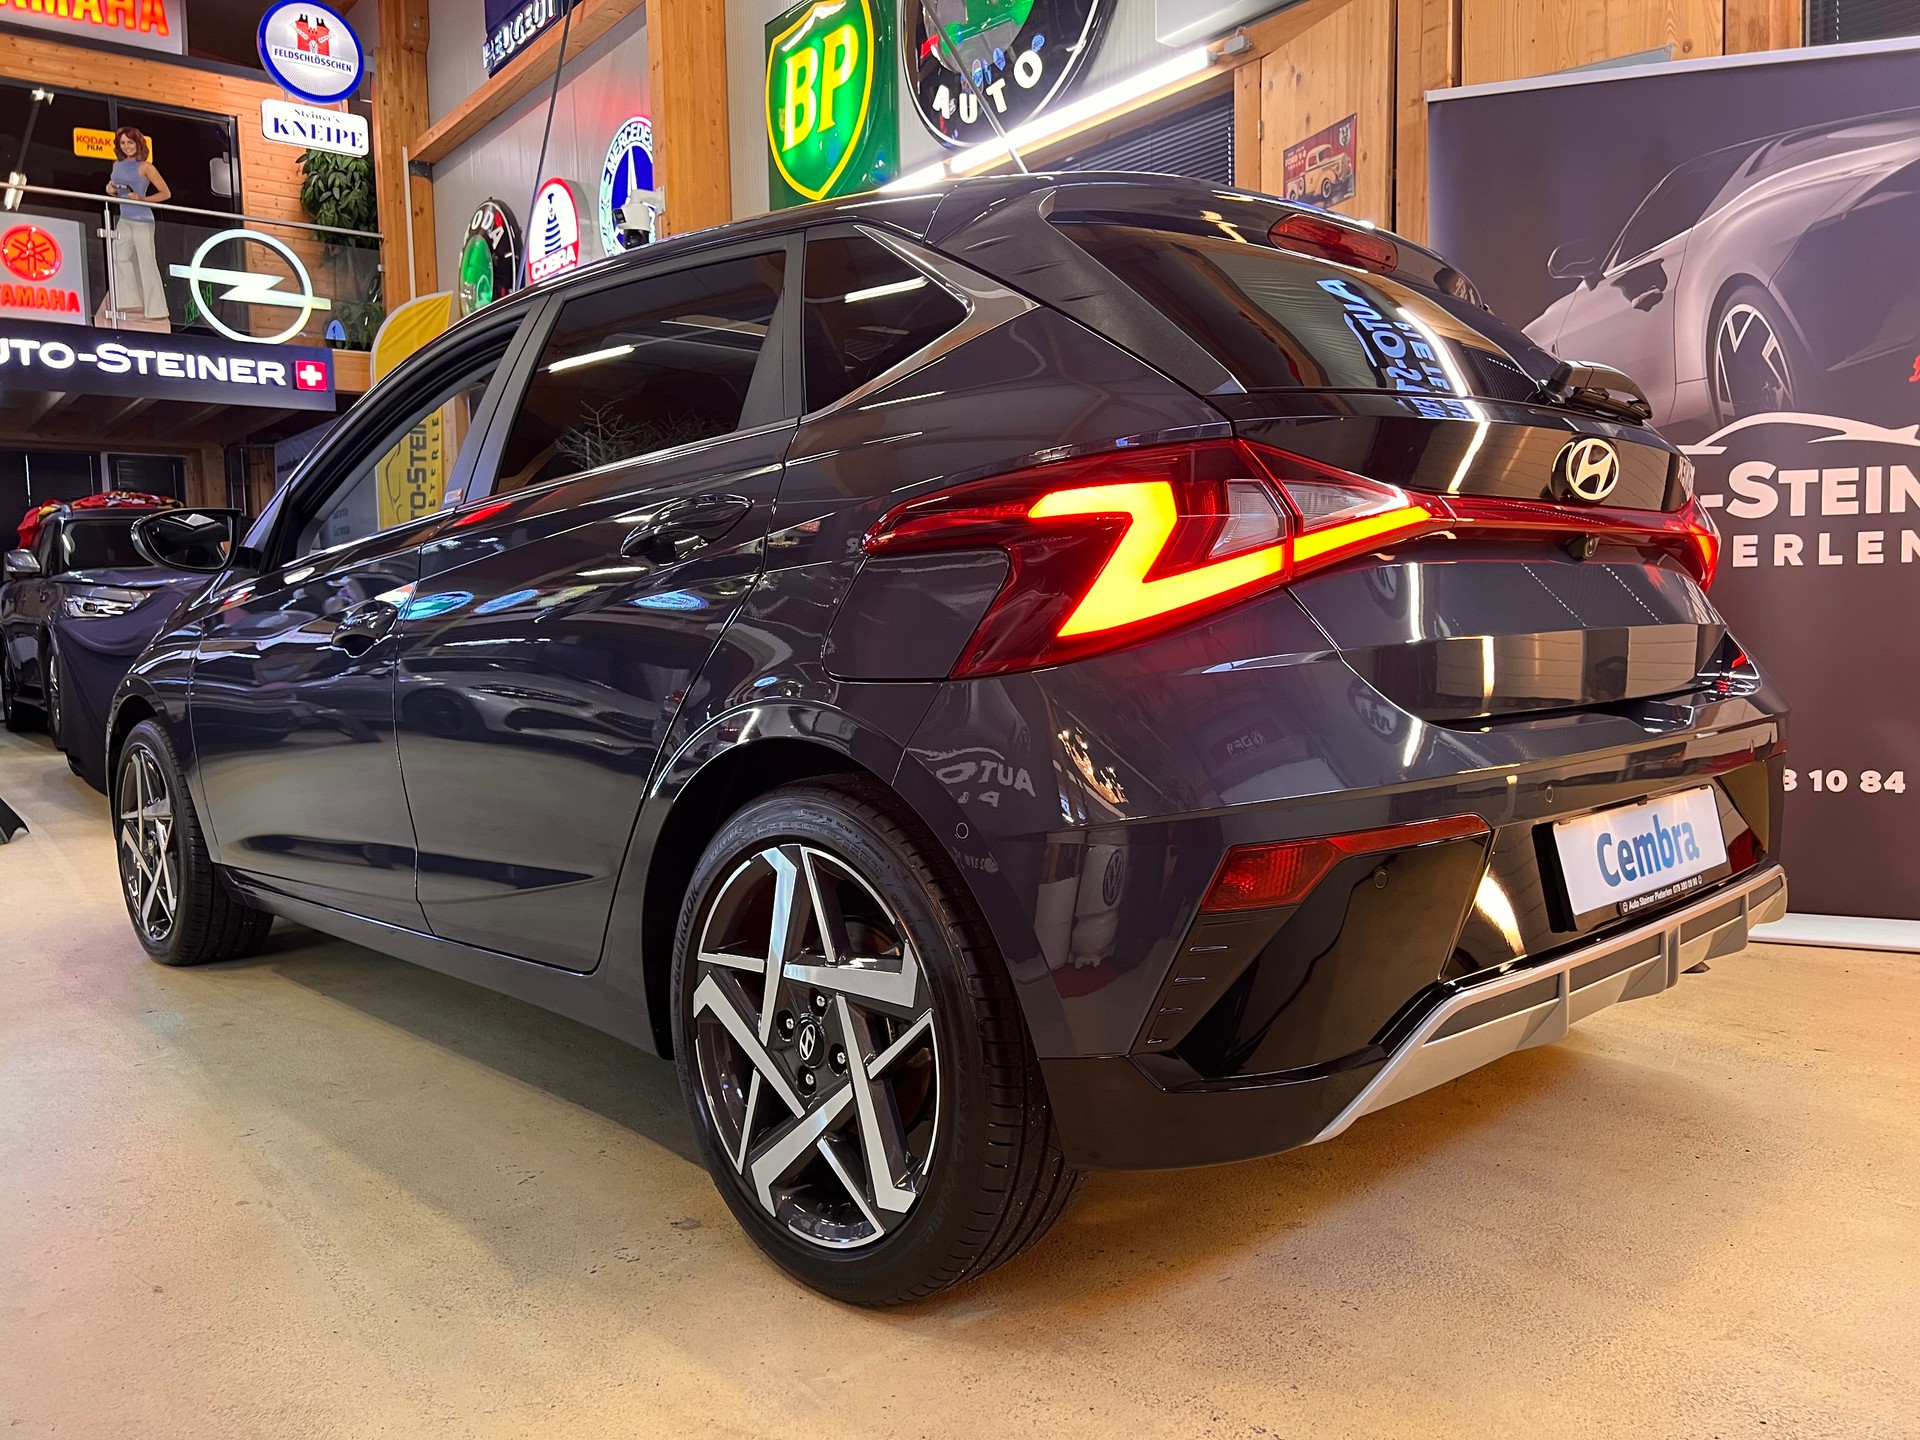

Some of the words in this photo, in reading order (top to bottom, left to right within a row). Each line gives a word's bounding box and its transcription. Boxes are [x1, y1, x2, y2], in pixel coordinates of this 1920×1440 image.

[0, 0, 169, 36] AHA
[274, 48, 352, 73] FELDSCHLÖSSCHEN
[782, 24, 859, 152] BP
[932, 50, 1043, 124] AUTO
[76, 135, 112, 147] KODAK
[86, 144, 103, 152] FILM
[273, 117, 364, 149] KNEIPE
[606, 121, 652, 173] MERCEDE
[464, 210, 504, 250] ODA
[531, 245, 577, 280] COBRA
[0, 284, 80, 313] AMAHA
[1732, 529, 1920, 567] ERLEN
[1808, 769, 1848, 792] 10
[1860, 770, 1906, 794] 84
[1596, 814, 1700, 887] Cembra
[1629, 900, 1640, 910] Auto
